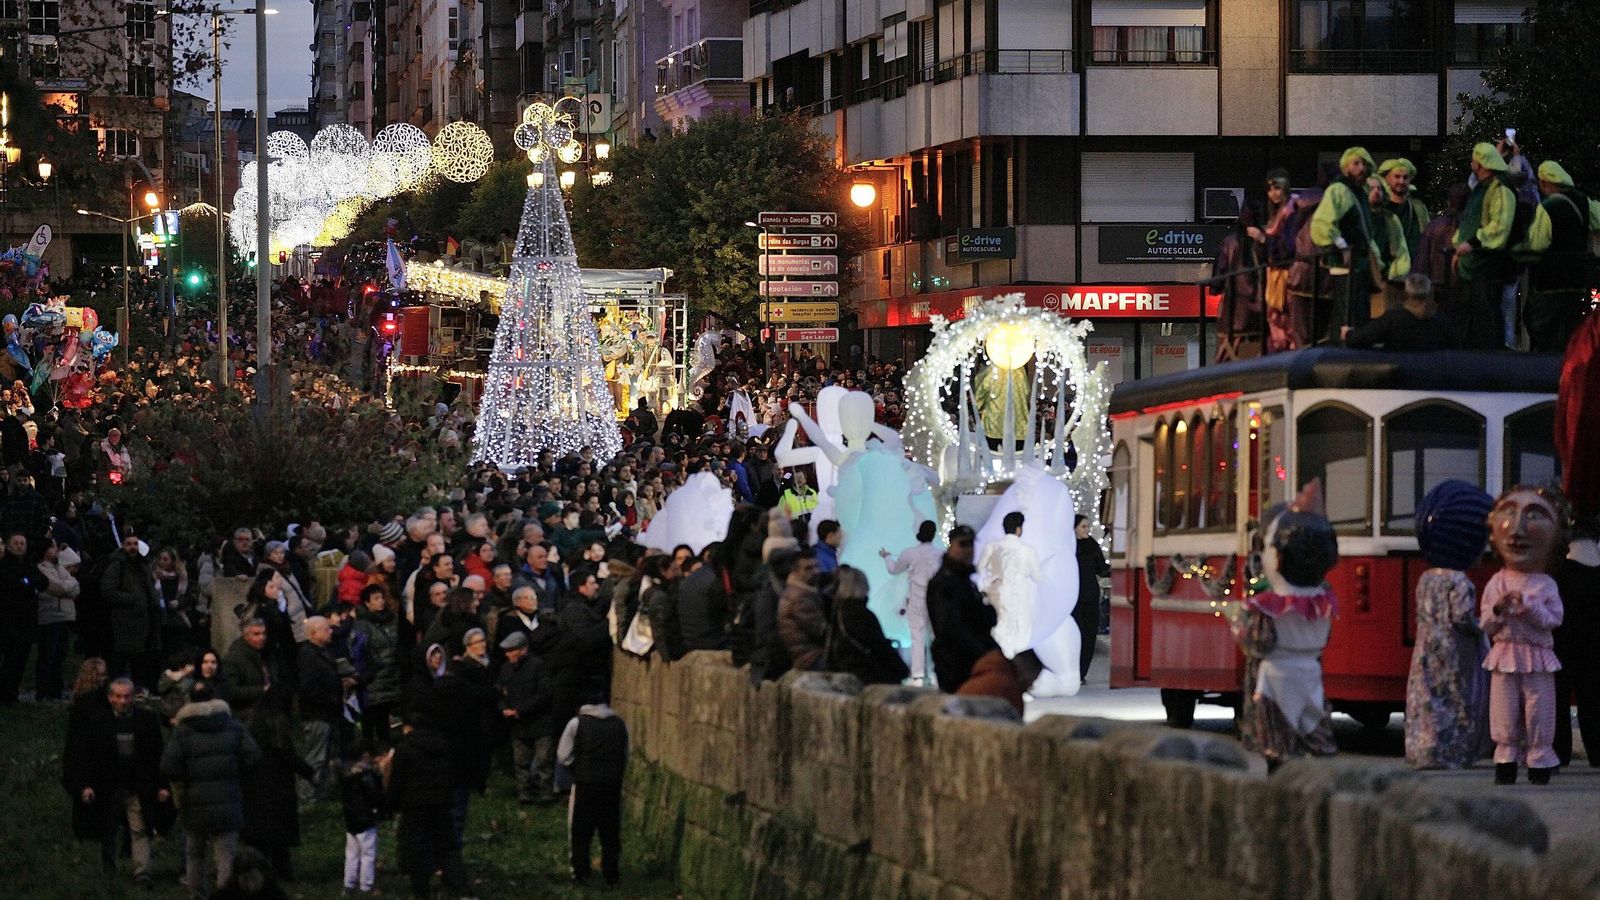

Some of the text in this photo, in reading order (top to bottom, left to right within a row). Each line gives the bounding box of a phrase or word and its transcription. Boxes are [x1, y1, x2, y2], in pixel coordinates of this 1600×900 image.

[961, 235, 1002, 246] e-drive
[1146, 229, 1204, 245] e-drive
[1147, 247, 1204, 255] AUTOESCUELA
[1061, 293, 1170, 310] MAPFRE
